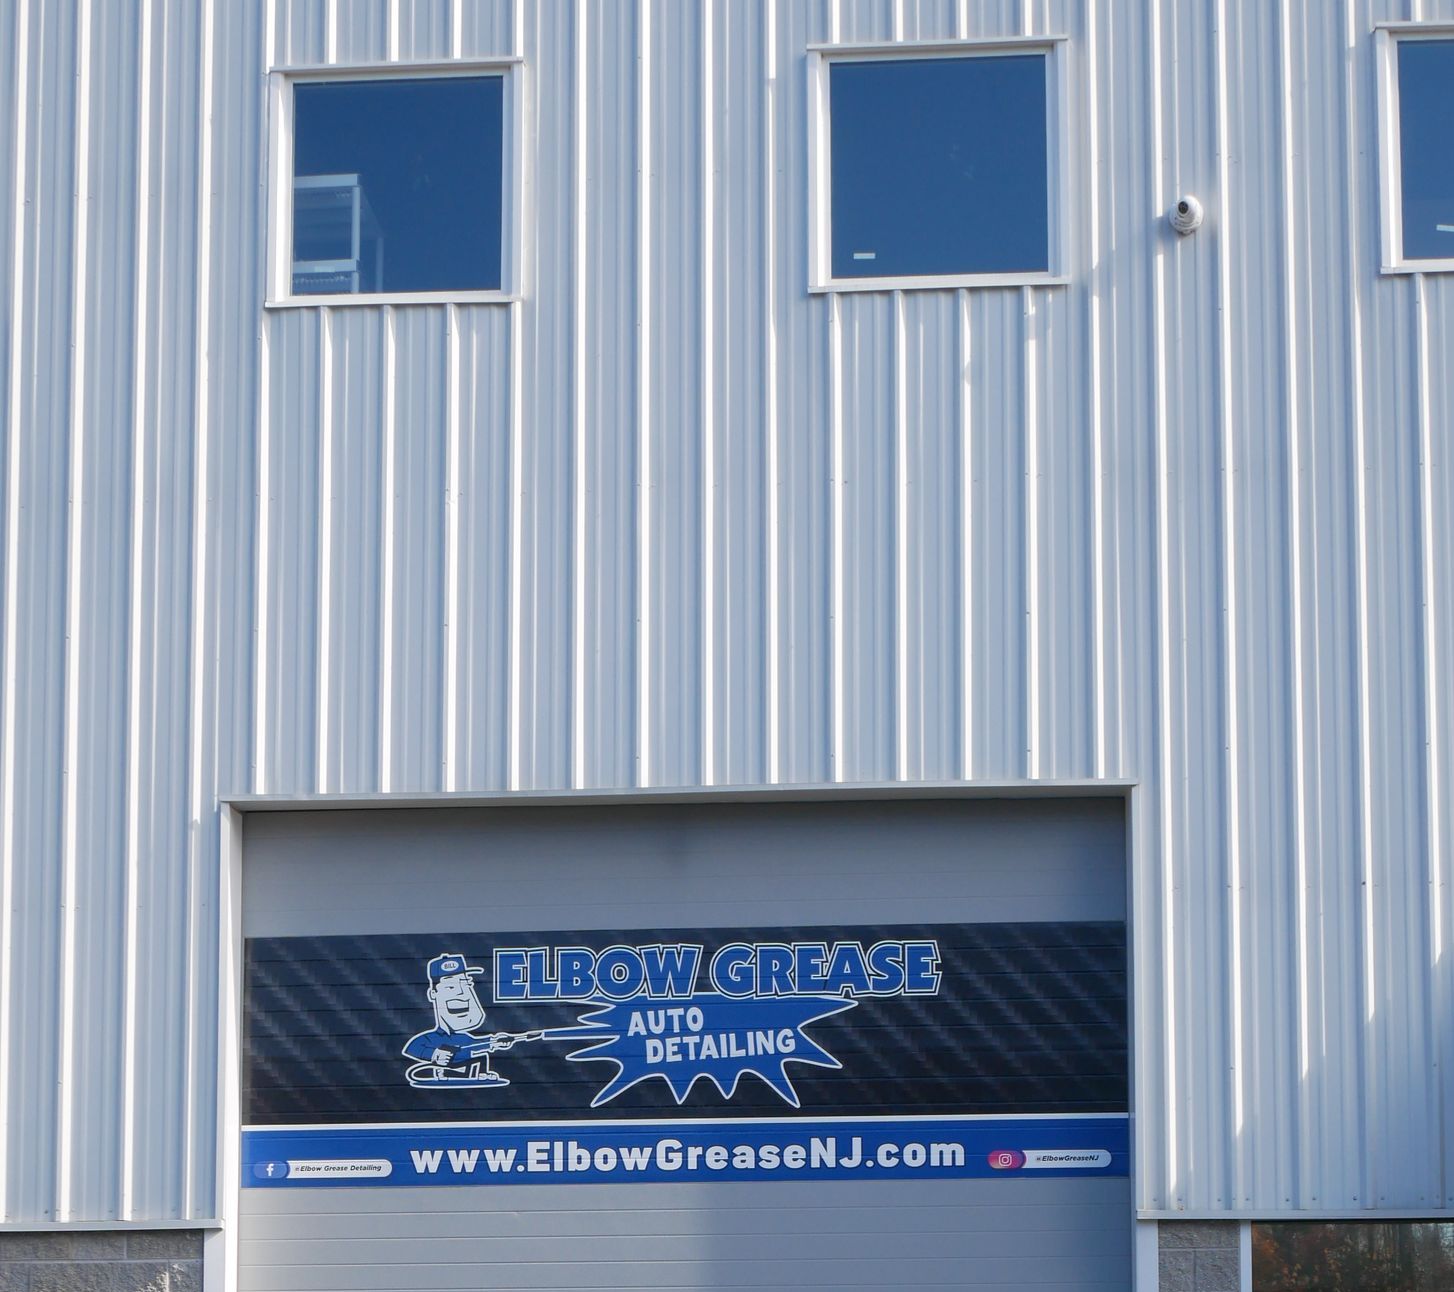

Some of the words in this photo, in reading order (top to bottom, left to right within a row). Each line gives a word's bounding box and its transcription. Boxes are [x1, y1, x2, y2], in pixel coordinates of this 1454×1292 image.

[493, 943, 703, 1003] ELBOW
[709, 940, 942, 999] GREASE
[627, 1007, 704, 1036] AUTO
[645, 1029, 796, 1064] DETAILING
[324, 1164, 348, 1172] Grease
[350, 1164, 382, 1172] Detailing
[410, 1137, 966, 1174] www.ElbowGreaseNJ.com
